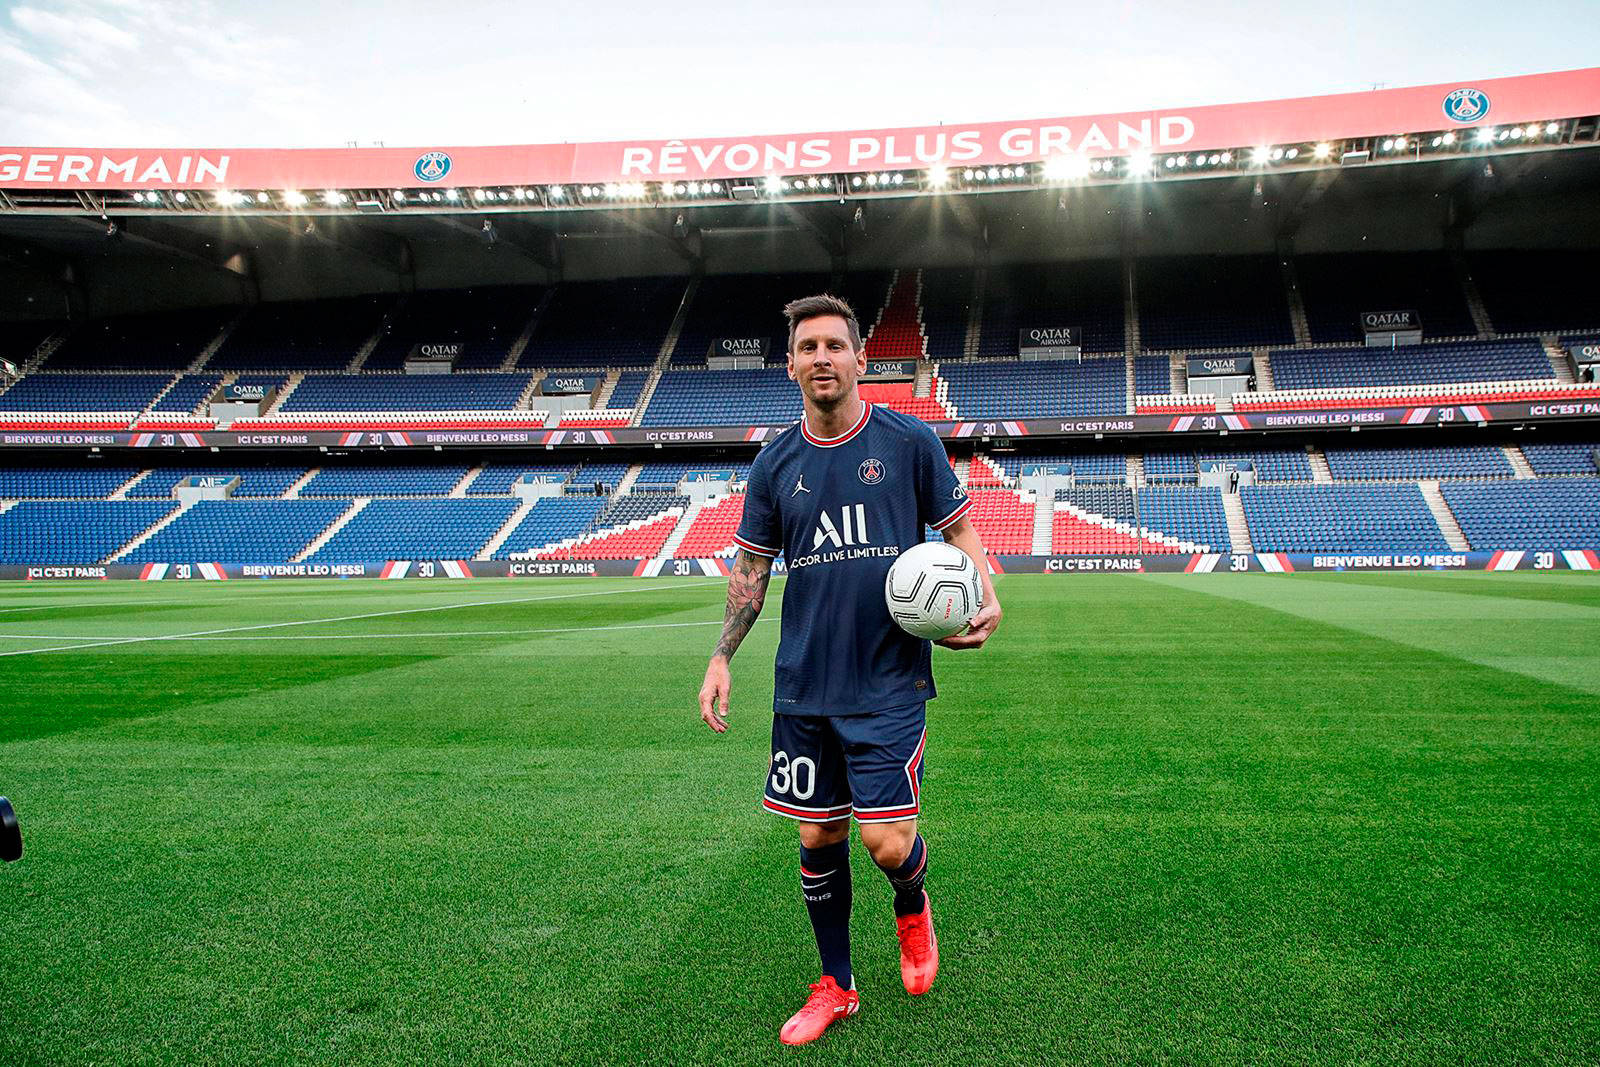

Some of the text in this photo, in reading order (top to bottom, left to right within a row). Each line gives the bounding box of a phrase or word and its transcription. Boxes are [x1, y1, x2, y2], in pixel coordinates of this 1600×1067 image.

[621, 116, 1195, 176] RÊVONS PLUS GRAND
[0, 154, 230, 183] GERMAIN
[1367, 312, 1410, 326] QATAR
[1030, 329, 1071, 341] QATAR
[723, 339, 761, 350] QATAR
[1040, 338, 1071, 346] AIRWAYS
[422, 344, 459, 355] QATAR
[874, 363, 903, 372] QATAR
[1203, 360, 1235, 369] QATAR
[556, 378, 584, 388] QATAR
[234, 385, 264, 394] QATAR
[1438, 407, 1454, 421] 30
[1530, 405, 1546, 416] ICI
[1548, 404, 1582, 415] C'EST
[1201, 416, 1216, 429] 30
[1266, 412, 1385, 426] BIENVENUE LEO MESSI
[983, 423, 996, 436] 30
[1061, 421, 1134, 431] ICI C'EST PARIS
[4, 435, 114, 444] BIENVENUE LEO MESSI
[161, 434, 174, 445] 30
[238, 435, 308, 444] ICI C'EST PARIS
[369, 434, 383, 445] 30
[426, 433, 528, 442] BIENVENUE LEO MESSI
[572, 432, 586, 443] 30
[646, 431, 714, 441] ICI C'EST PARIS
[823, 550, 845, 563] LIVE
[847, 546, 899, 559] LIMITLESS
[1534, 551, 1554, 569] 30
[1045, 558, 1142, 570] ICI C'EST PARIS
[1229, 554, 1249, 571] 30
[1313, 555, 1466, 567] BIENVENUE LEO MESSI
[28, 567, 106, 577] ICI C'EST PARIS
[176, 564, 192, 579] 30
[243, 564, 365, 575] BIENVENUE LEO MESSI
[418, 562, 435, 577] 30
[509, 563, 595, 574] ICI C'EST PARIS
[673, 560, 690, 575] 30
[771, 750, 816, 800] 30
